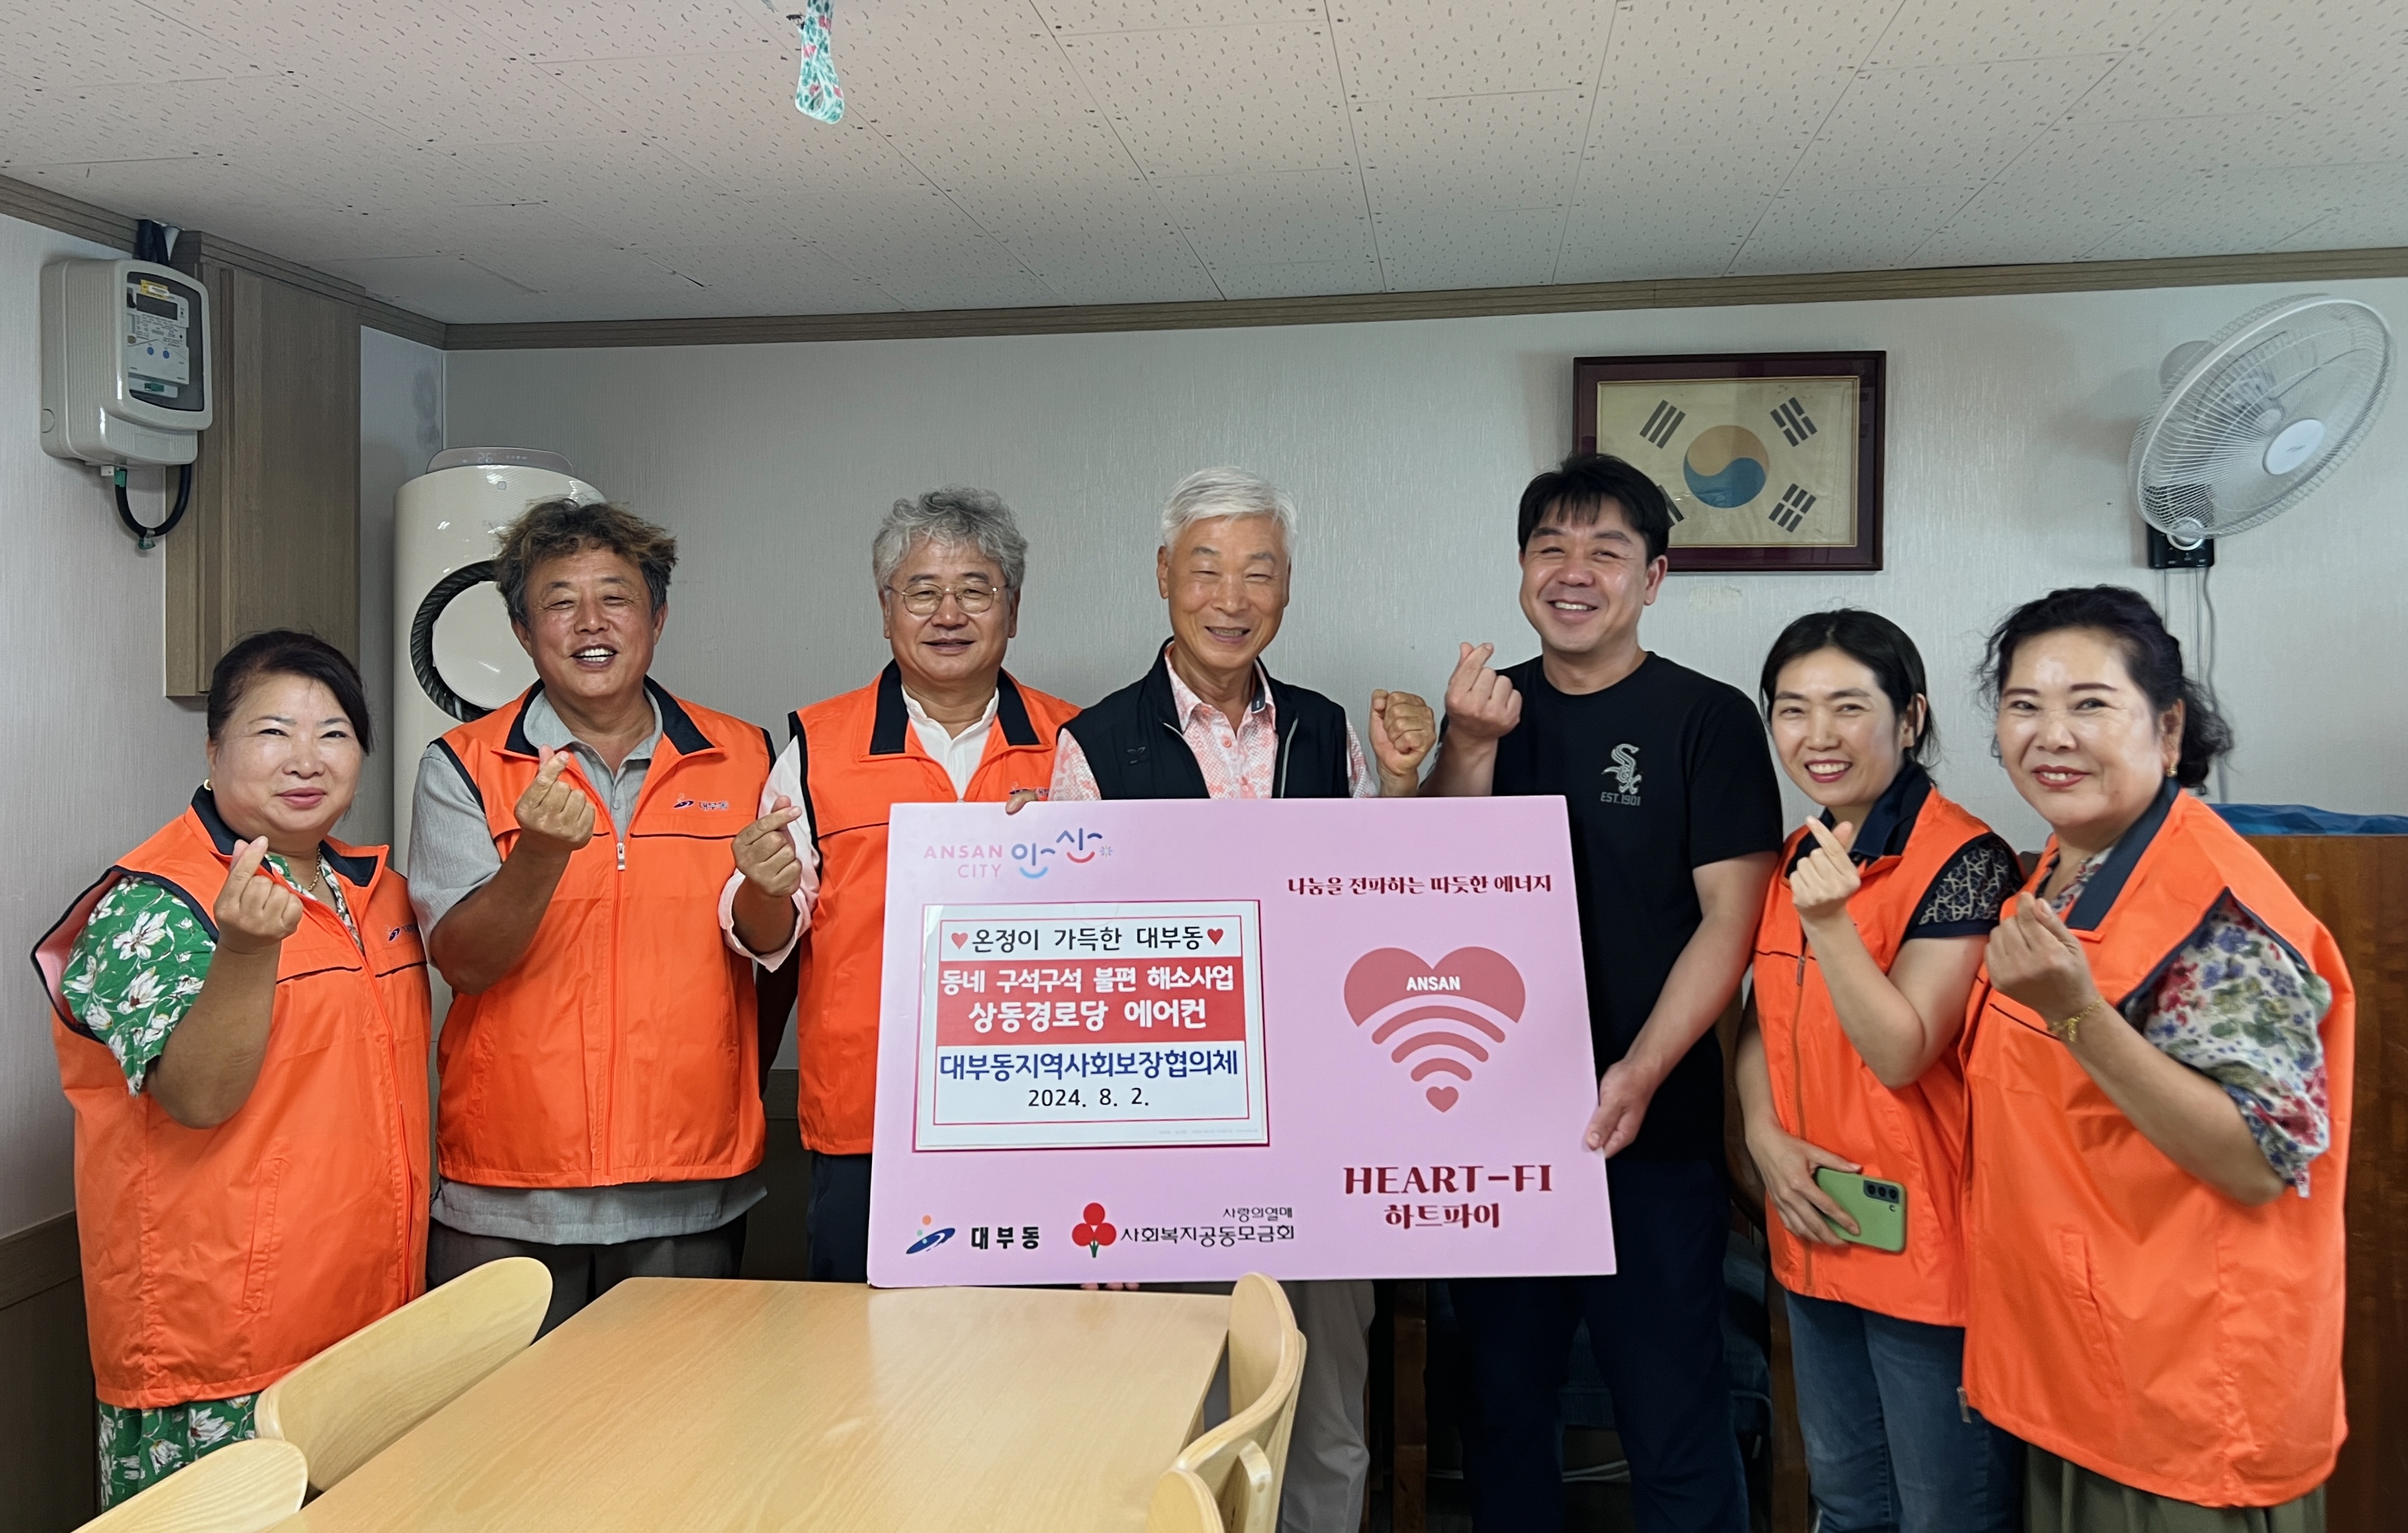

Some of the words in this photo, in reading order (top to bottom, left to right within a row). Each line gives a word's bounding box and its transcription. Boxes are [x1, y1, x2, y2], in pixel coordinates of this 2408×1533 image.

[924, 844, 1003, 859] ANSAN
[957, 864, 1001, 878] CITY
[1288, 877, 1344, 895] 나눔을
[1349, 876, 1425, 895] 전파하는
[1430, 876, 1489, 894] 따듯한
[1494, 874, 1551, 893] 에너지
[972, 929, 1039, 953] 온정이
[1054, 926, 1123, 951] 가득한
[1136, 926, 1203, 950] 대부동
[941, 969, 985, 996] 동네
[996, 968, 1082, 994] 구석구석
[1093, 967, 1137, 993] 불편
[1146, 964, 1234, 992] 해소사업
[1406, 976, 1461, 992] ANSAN
[968, 1000, 1109, 1033] 상동경로당
[1124, 998, 1207, 1029] 에어컨
[939, 1049, 1238, 1082] 대부동지역사회보장협의체
[1028, 1089, 1087, 1108] 2024.
[1099, 1088, 1118, 1107] 8.
[1131, 1087, 1149, 1106] 2.
[1343, 1165, 1553, 1195] HEART-FI
[1222, 1206, 1293, 1223] 사랑의열매
[1384, 1202, 1500, 1230] 하트파이
[970, 1226, 1040, 1250] 대부동
[1120, 1224, 1294, 1248] 사회복지공동모금회
